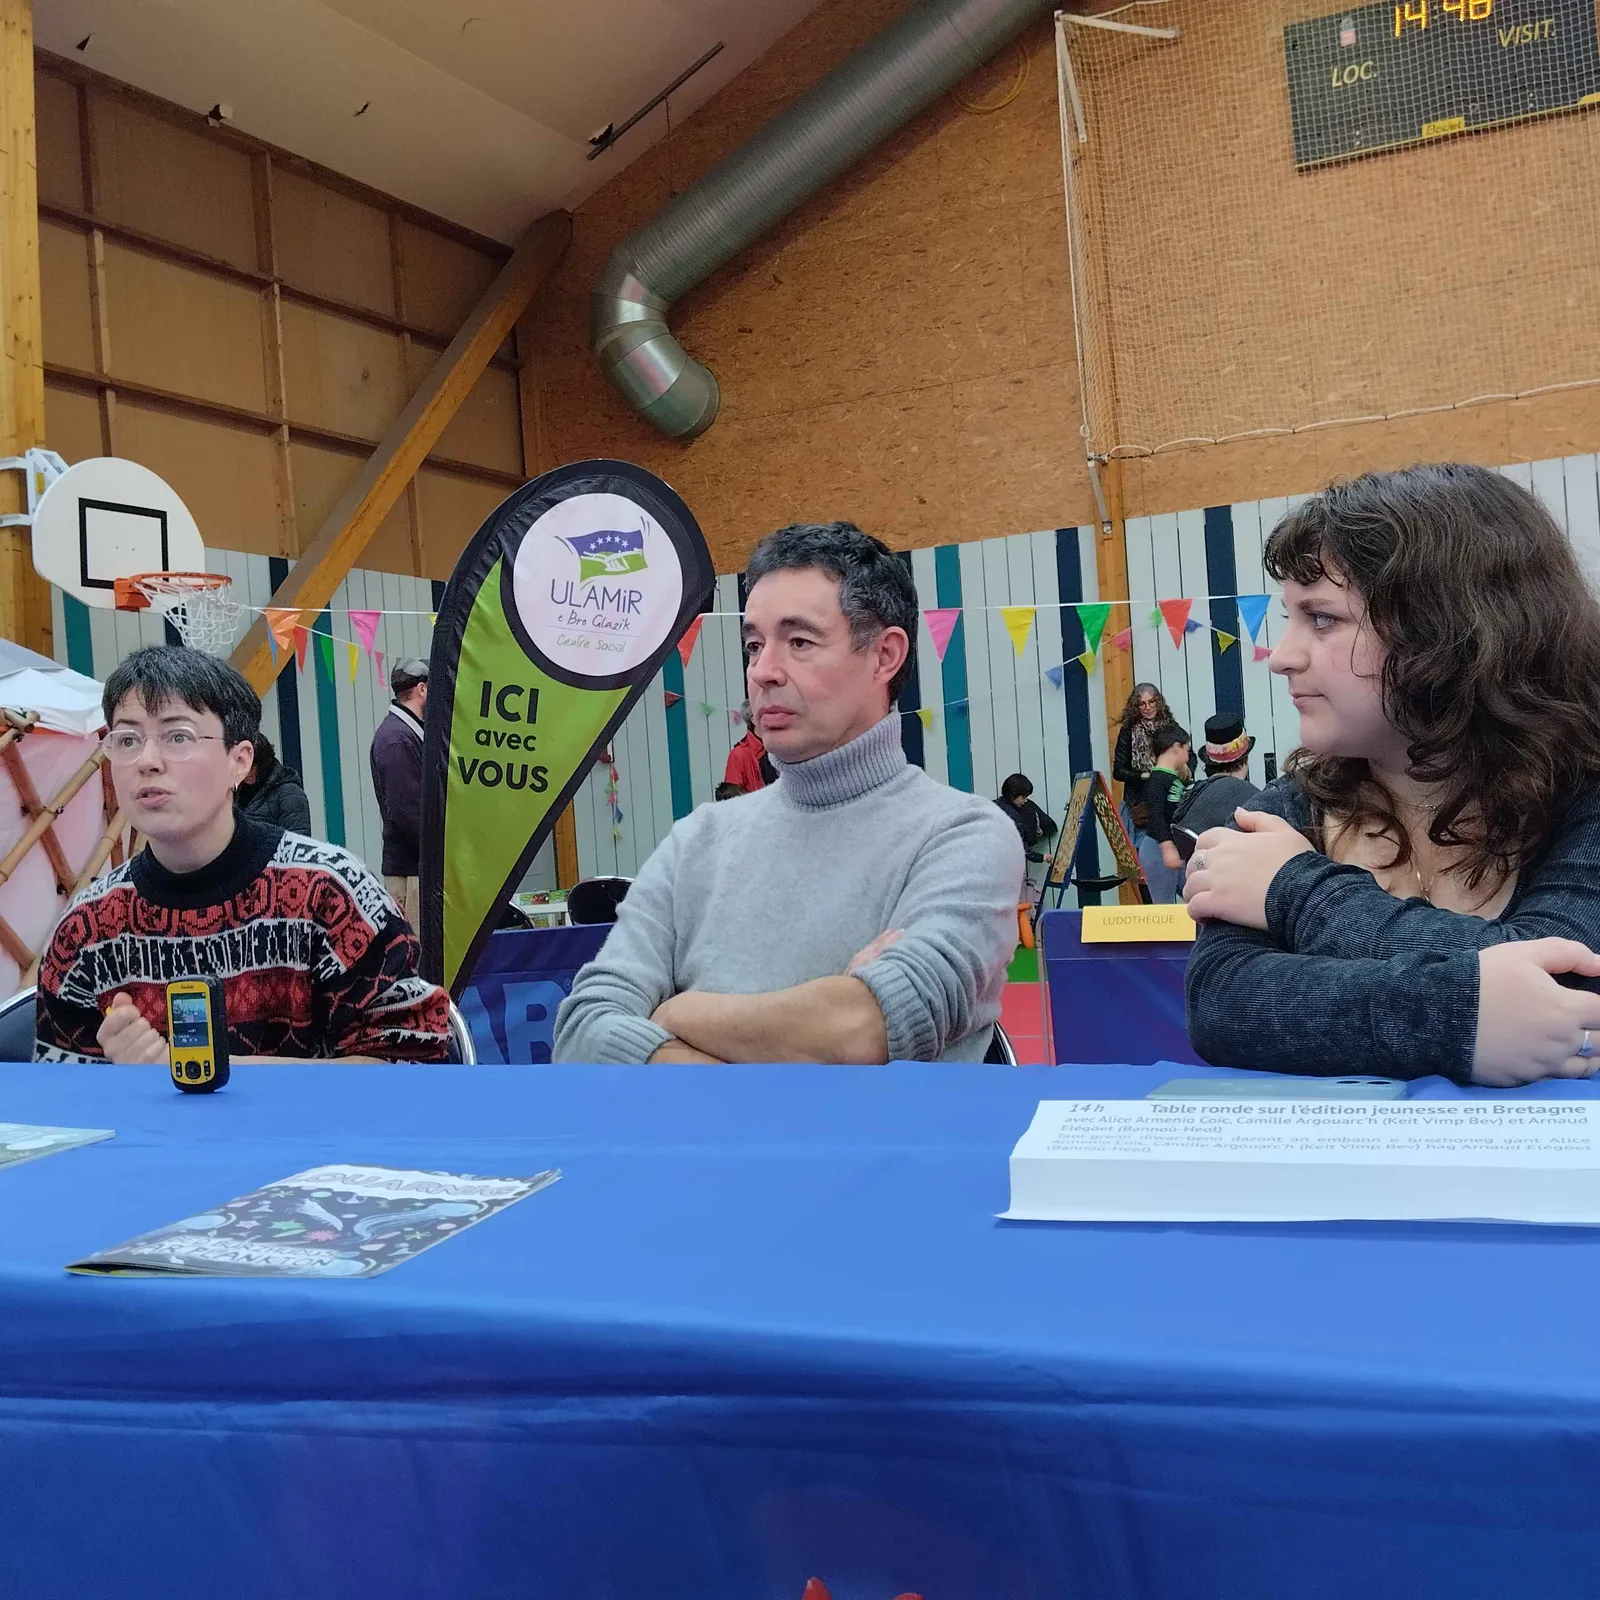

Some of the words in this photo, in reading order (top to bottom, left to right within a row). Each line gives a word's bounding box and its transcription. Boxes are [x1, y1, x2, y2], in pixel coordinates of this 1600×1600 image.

[1498, 18, 1556, 48] VISIT.
[1332, 61, 1377, 87] LOC.
[567, 609, 587, 626] Bro
[592, 614, 631, 631] Glazik
[557, 634, 590, 649] Centre
[479, 680, 540, 725] ICI
[475, 728, 537, 752] avec
[457, 756, 549, 794] VOUS
[1069, 1103, 1093, 1113] 14
[1093, 1103, 1105, 1113] h
[1150, 1104, 1197, 1114] Table
[1201, 1105, 1253, 1114] ronde
[1371, 1105, 1458, 1116] jeunesse
[1492, 1105, 1586, 1116] Bretagne
[1098, 1116, 1132, 1124] Alice
[1135, 1116, 1195, 1124] Armenio
[1236, 1117, 1292, 1125] Camille
[1382, 1117, 1419, 1126] (Keit
[1422, 1117, 1463, 1126] Vimp
[1468, 1117, 1503, 1126] Bev)
[1527, 1117, 1588, 1125] Arnaud
[187, 1247, 335, 1267] PLANKTON
